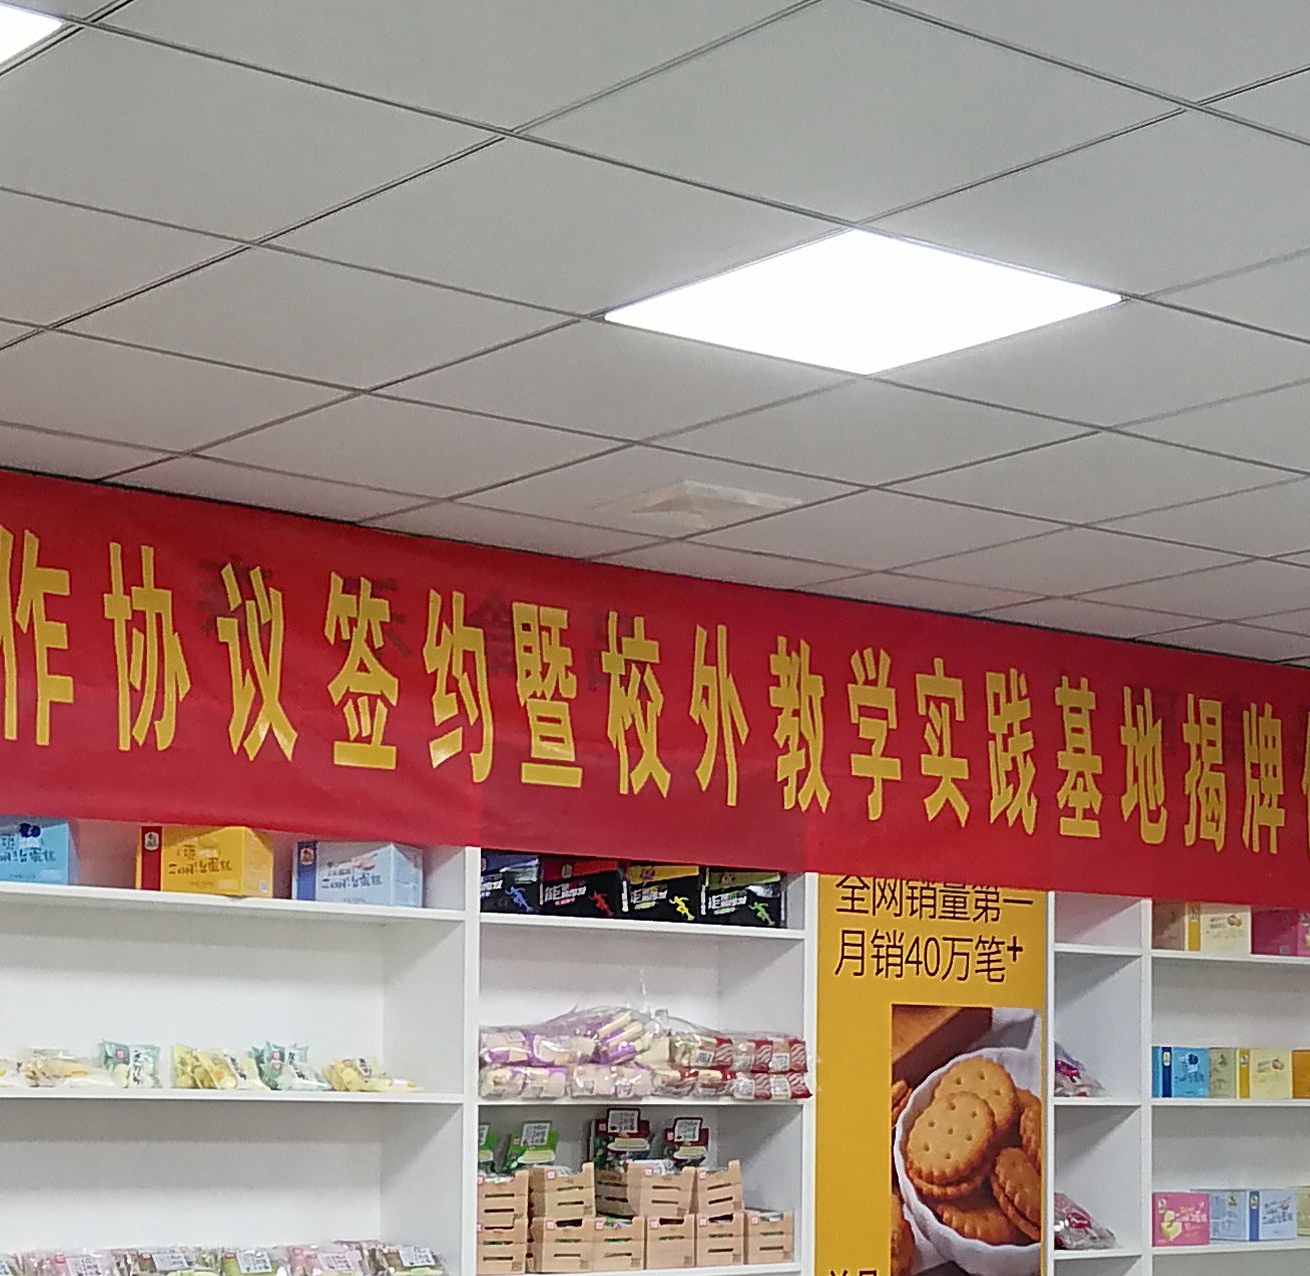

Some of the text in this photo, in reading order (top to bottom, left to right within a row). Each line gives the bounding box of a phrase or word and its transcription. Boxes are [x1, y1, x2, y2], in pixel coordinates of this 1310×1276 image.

[835, 875, 1034, 923] 全网销量第一
[835, 929, 1024, 983] 月销40万笔+
